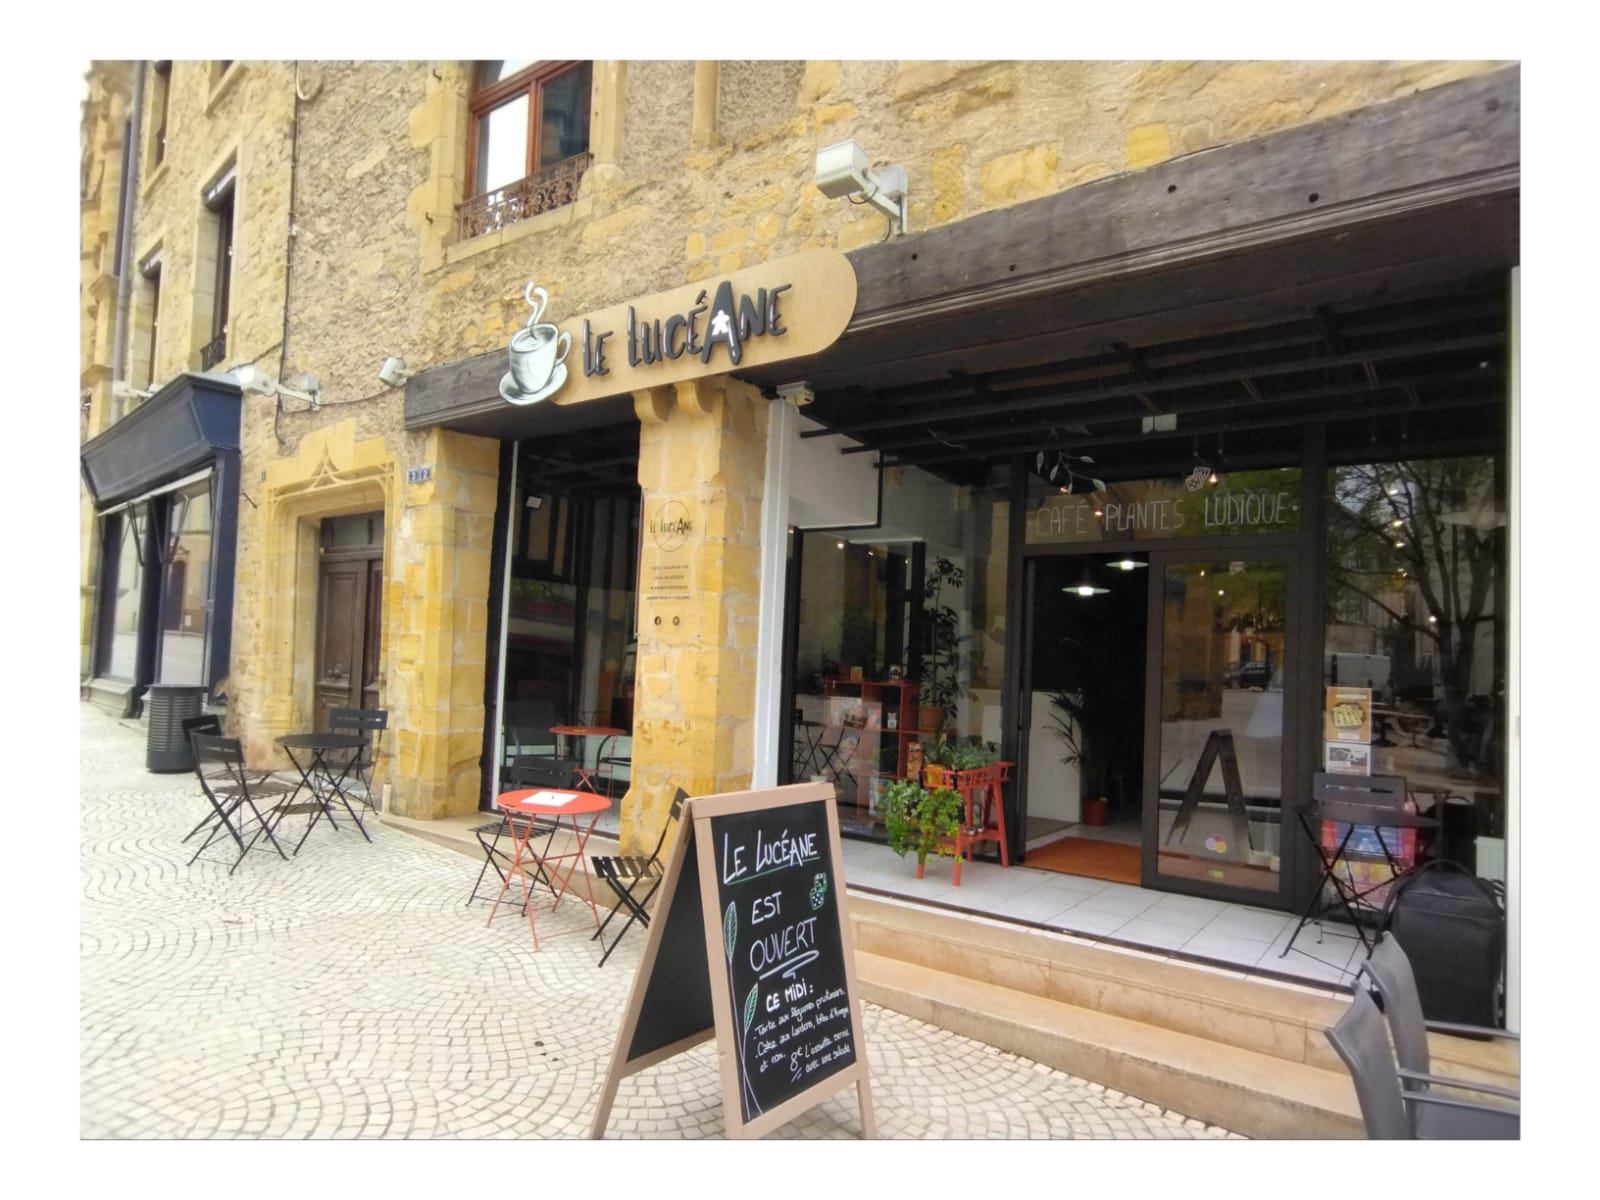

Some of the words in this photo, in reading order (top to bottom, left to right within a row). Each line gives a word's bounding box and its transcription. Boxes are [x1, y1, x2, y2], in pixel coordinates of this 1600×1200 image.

[583, 319, 613, 378] LE
[627, 280, 792, 367] LUCÉANE
[1036, 500, 1089, 536] CAFÉ
[1105, 500, 1184, 531] PLANTES
[1204, 493, 1289, 526] LUDIQUE
[723, 833, 747, 884] LE
[756, 828, 818, 872] LUCÉANE
[752, 891, 782, 925] EST
[750, 917, 817, 972] OUVERT
[766, 993, 780, 1012] CE
[779, 1013, 790, 1025] aux
[779, 1034, 791, 1044] aux
